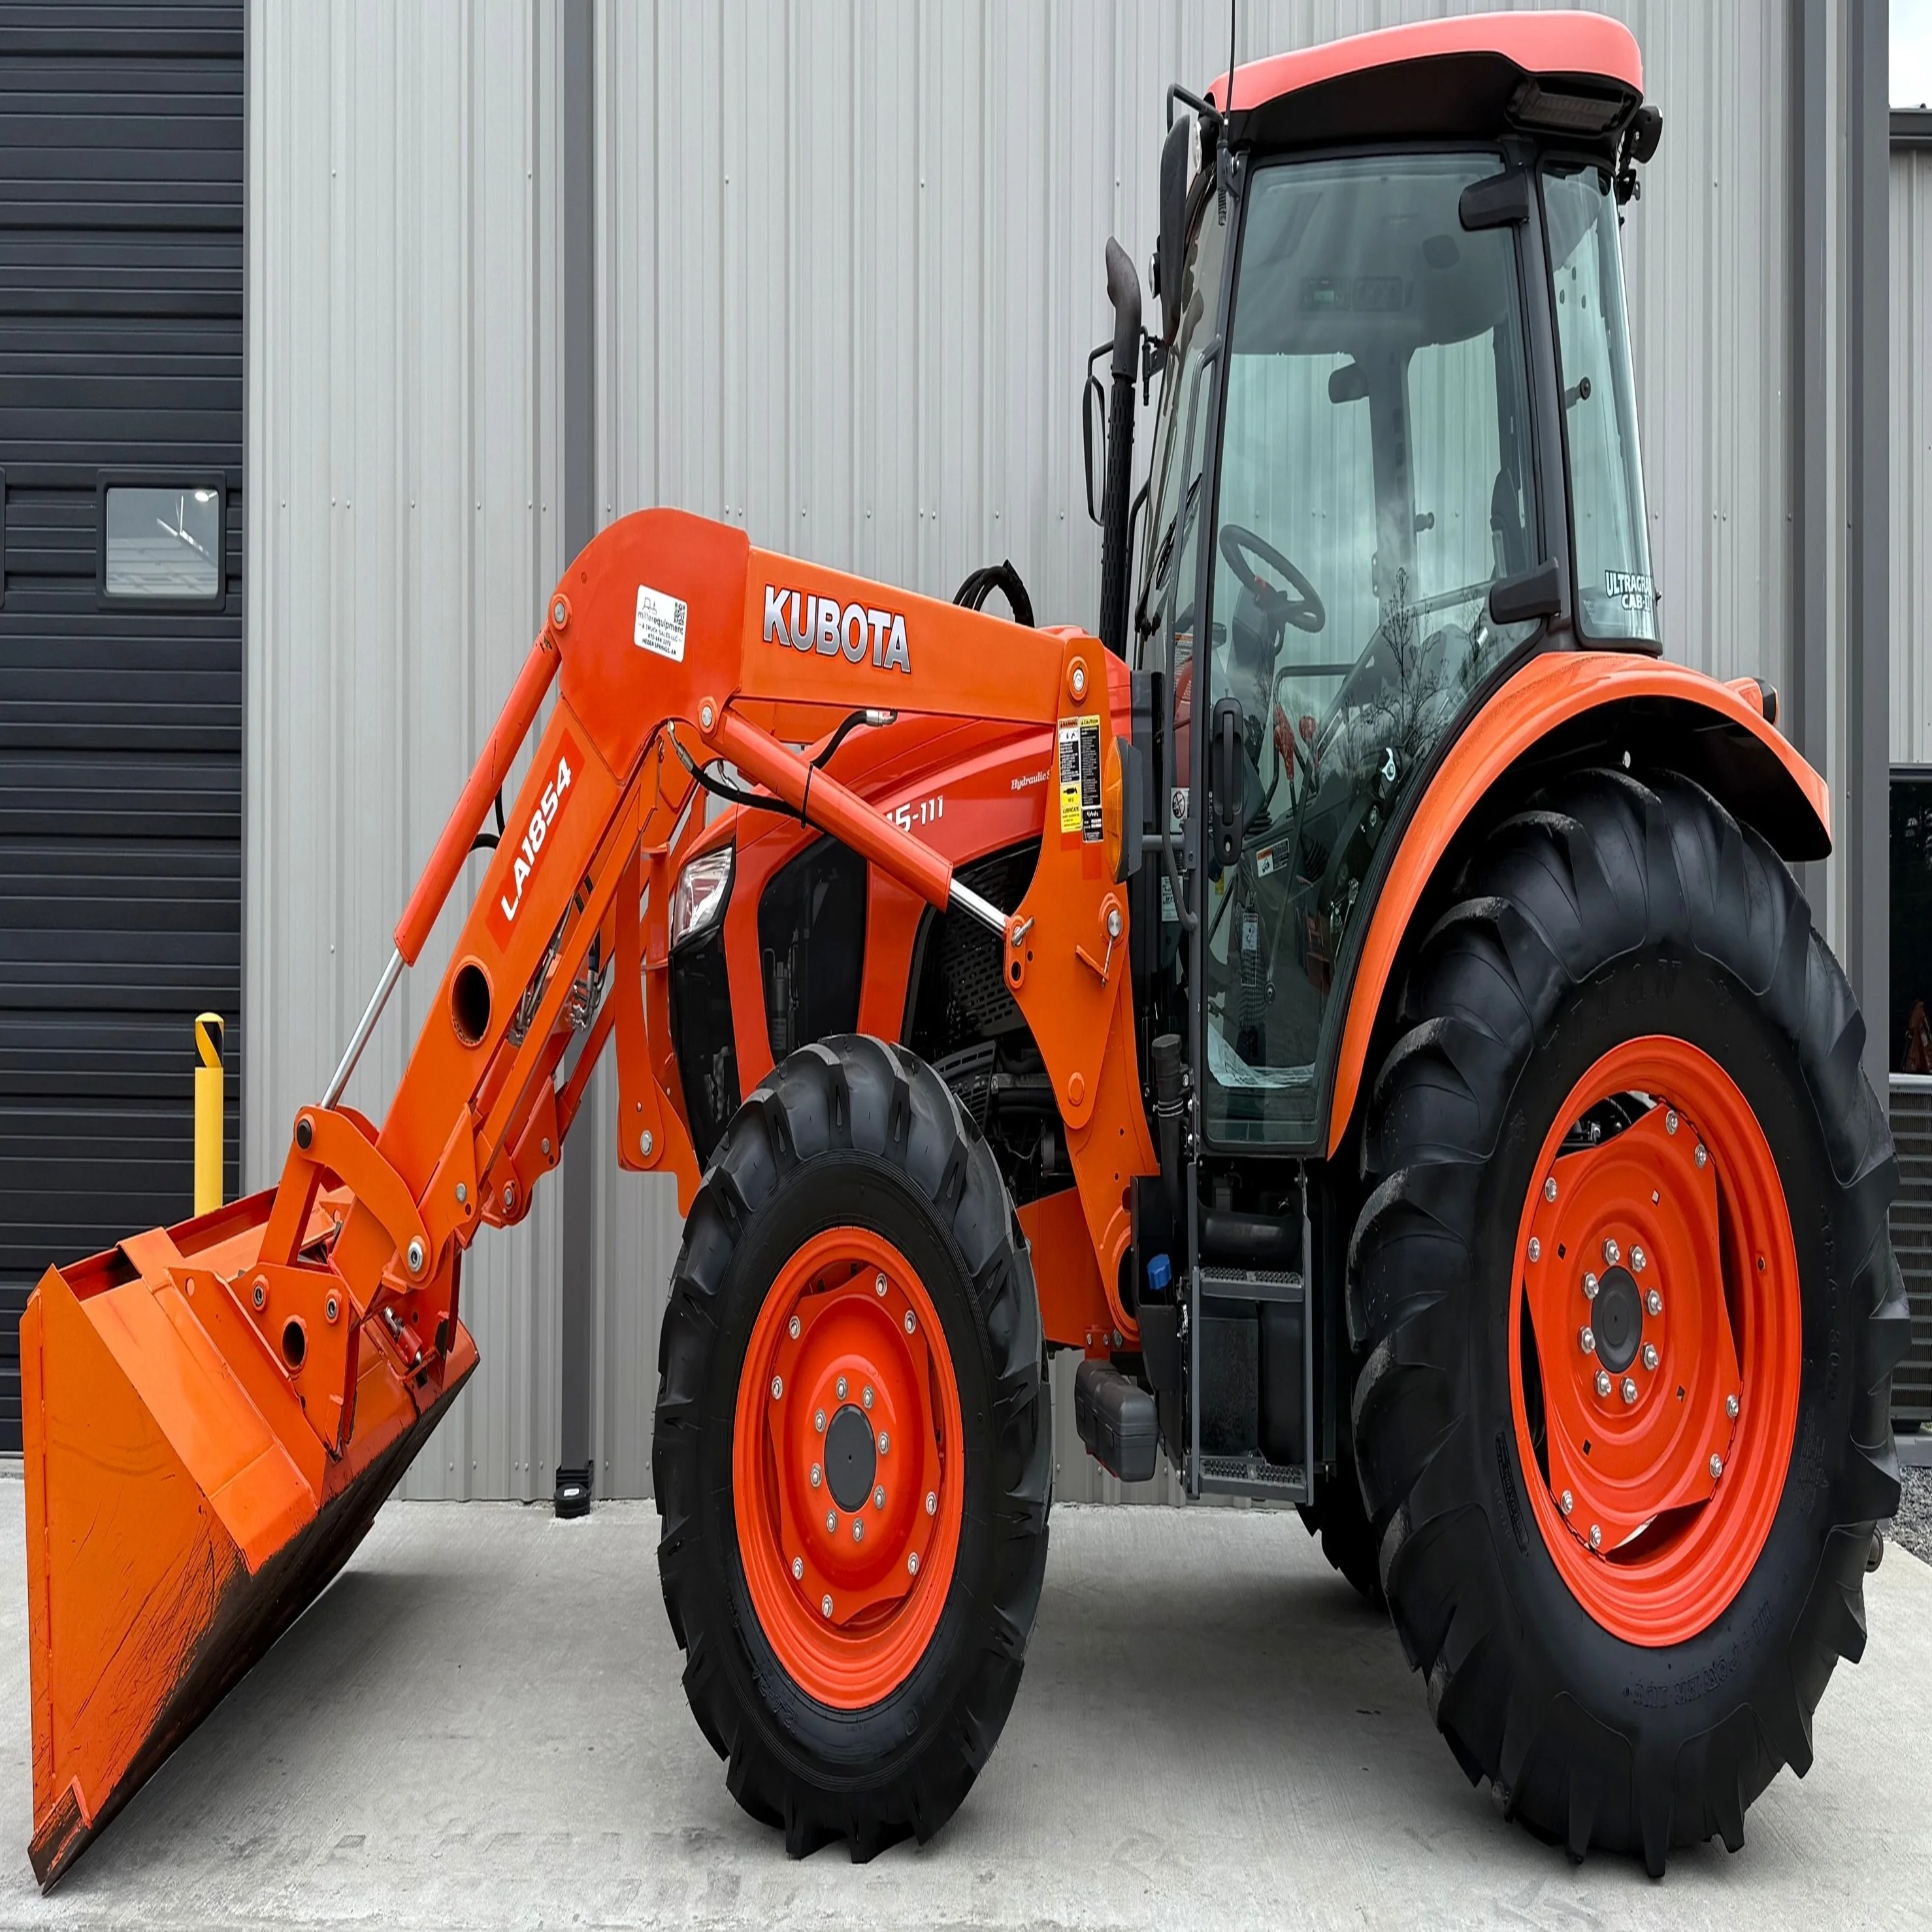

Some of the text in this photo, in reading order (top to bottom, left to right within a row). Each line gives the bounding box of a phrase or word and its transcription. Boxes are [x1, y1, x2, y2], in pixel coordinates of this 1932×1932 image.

[646, 623, 657, 634] TRUCK
[659, 629, 670, 640] SALES
[764, 583, 911, 674] KUBOTA
[1010, 771, 1046, 791] Hydraulic
[501, 756, 571, 922] LA1854
